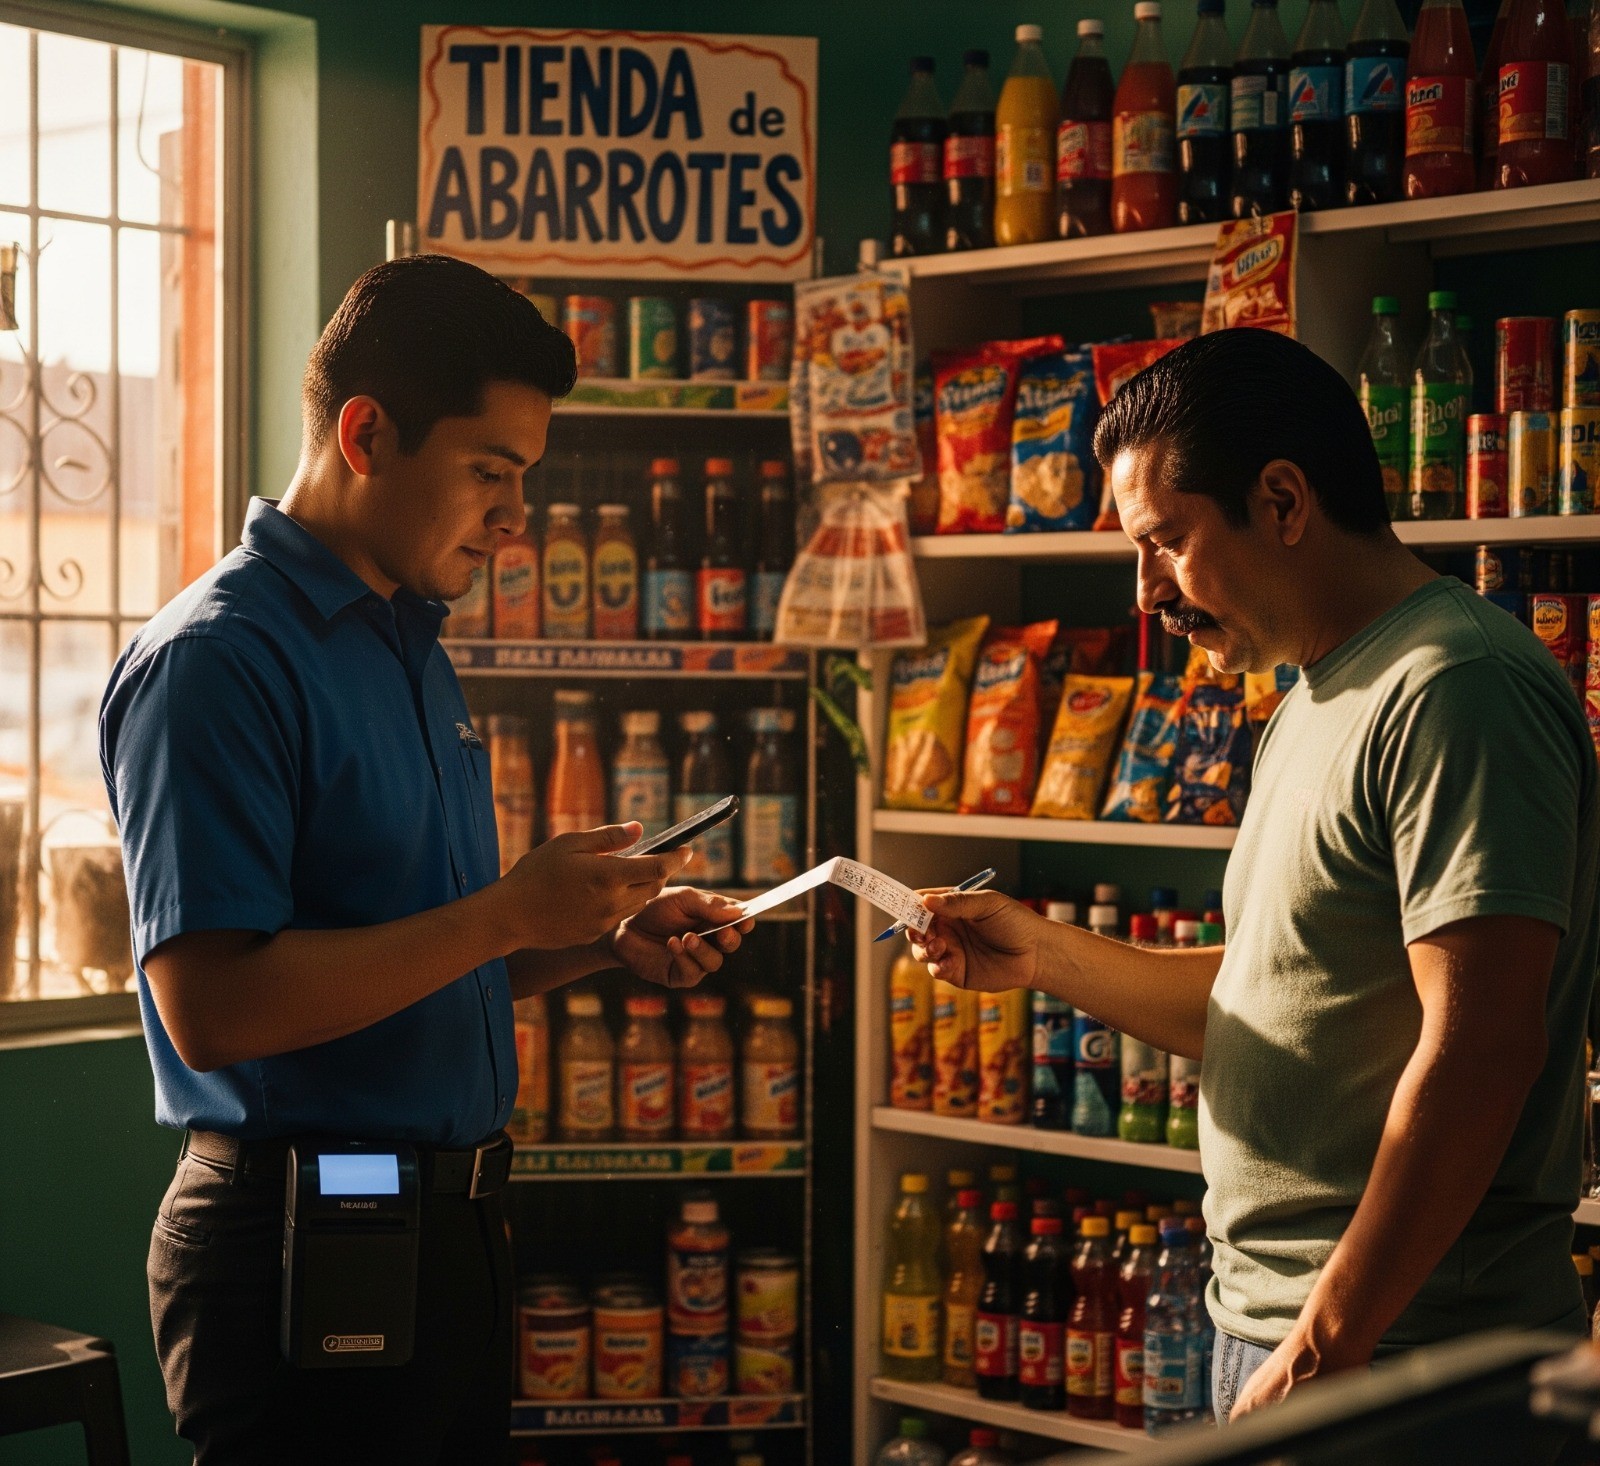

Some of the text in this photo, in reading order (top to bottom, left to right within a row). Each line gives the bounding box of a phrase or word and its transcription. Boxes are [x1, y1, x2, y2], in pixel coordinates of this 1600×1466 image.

[449, 45, 785, 139] TIENDA de
[428, 146, 801, 247] ABARROTES
